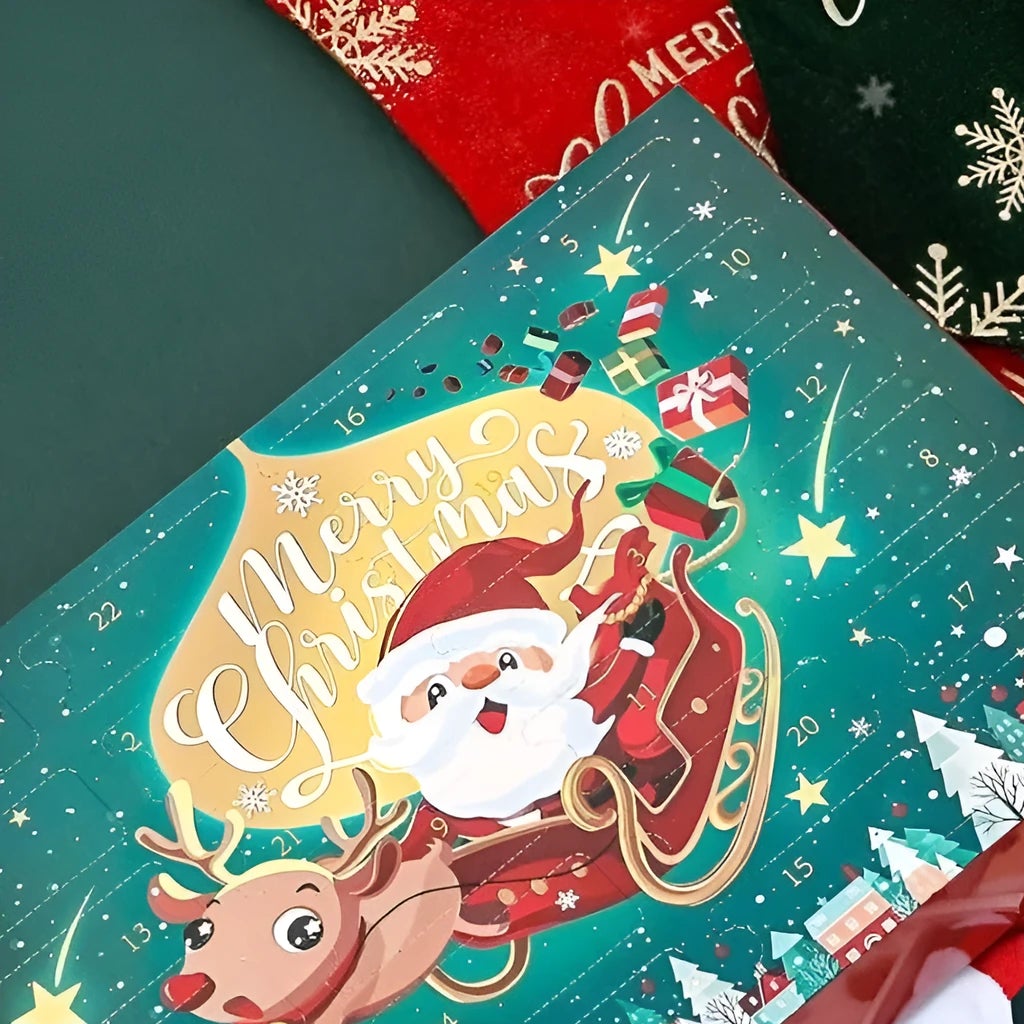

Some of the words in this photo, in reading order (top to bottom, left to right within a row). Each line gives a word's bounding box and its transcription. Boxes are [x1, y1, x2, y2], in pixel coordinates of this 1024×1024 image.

[560, 234, 579, 254] 5
[720, 248, 752, 277] 10
[795, 375, 827, 403] 12
[333, 406, 365, 435] 16
[919, 448, 939, 467] 8
[474, 470, 503, 496] 19
[217, 408, 520, 647] Merry
[626, 548, 646, 567] 3
[947, 580, 976, 612] 17
[88, 601, 122, 631] 22
[163, 420, 608, 809] Christmas
[626, 683, 657, 711] 11
[121, 732, 143, 752] 2
[786, 714, 820, 747] 20
[430, 817, 448, 837] 9
[271, 830, 302, 857] 21
[782, 856, 815, 887] 15
[121, 922, 151, 952] 13
